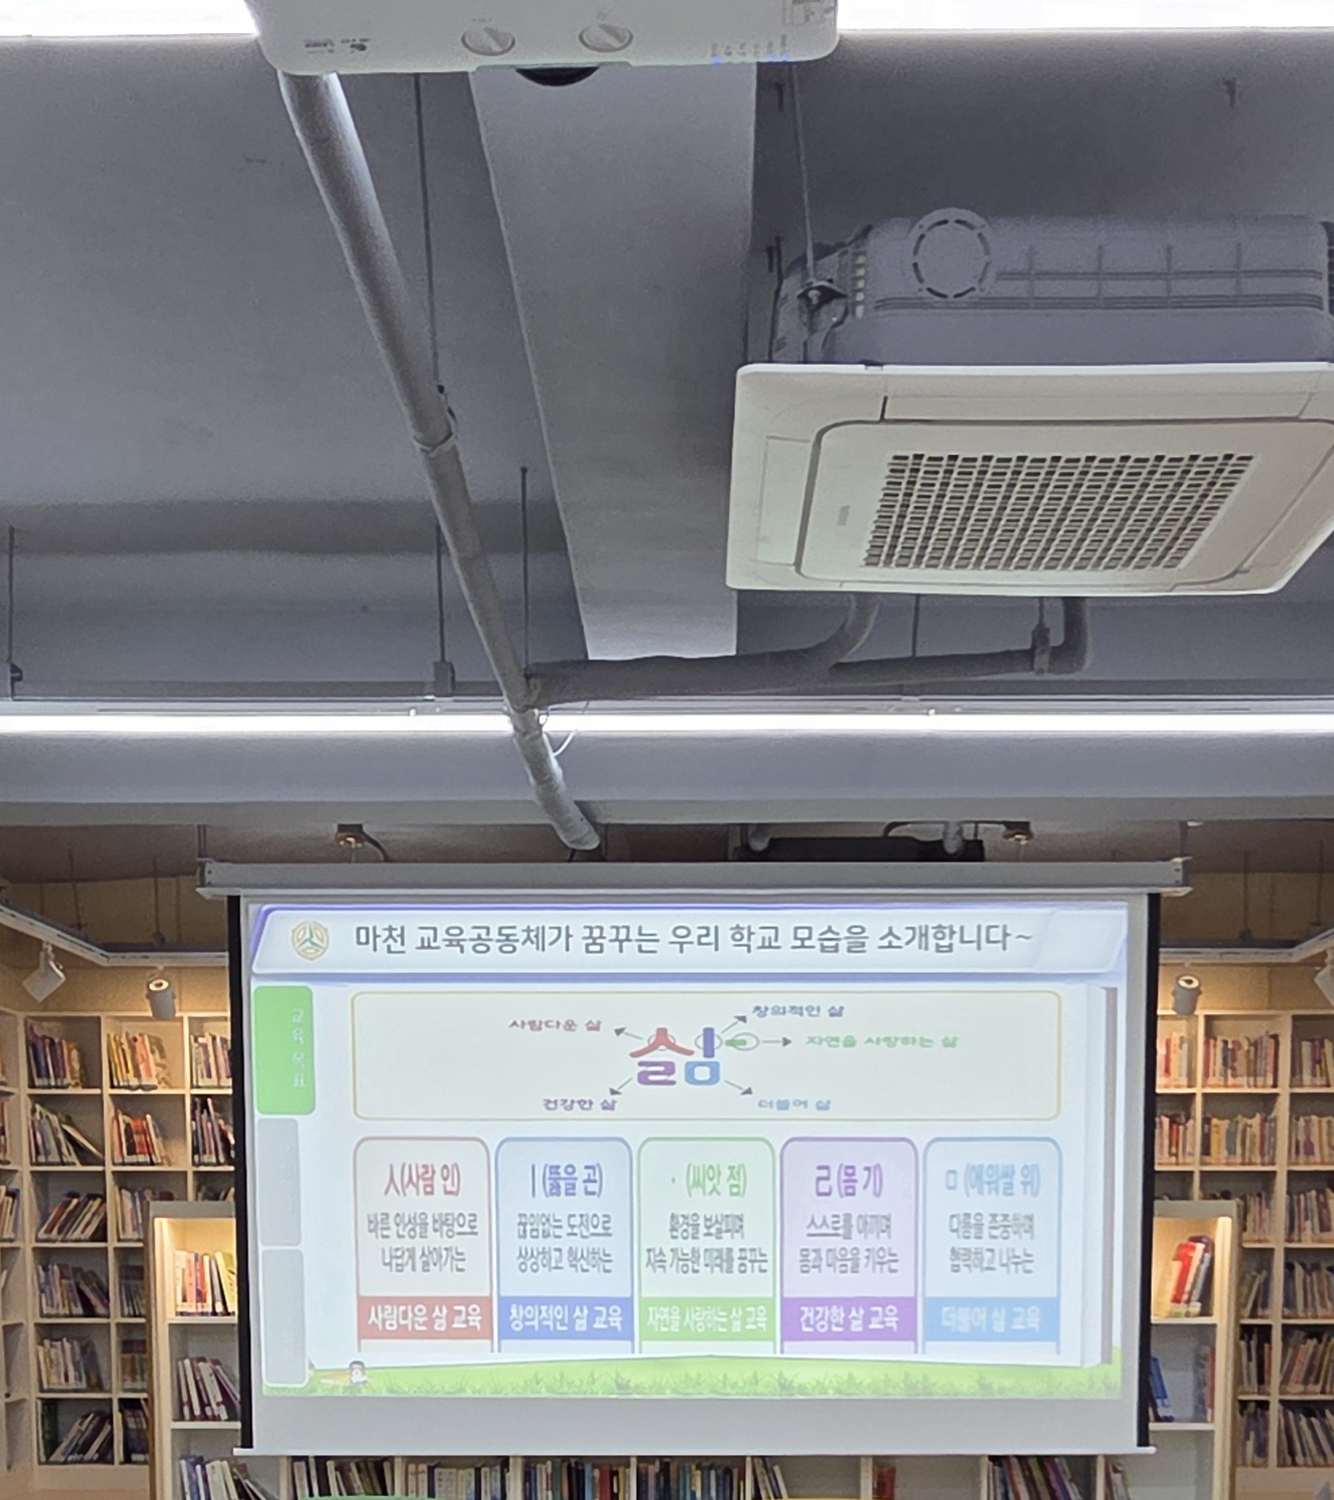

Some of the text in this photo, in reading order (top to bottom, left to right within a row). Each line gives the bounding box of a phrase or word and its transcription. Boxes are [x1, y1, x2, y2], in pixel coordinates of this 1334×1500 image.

[355, 924, 1034, 954] 마천 교육공동체가 꿈꾸는 우리 학교 모습을 소개합니다~
[509, 1018, 601, 1032] 사람다운 삶
[752, 1004, 845, 1018] 창의적인 삶
[805, 1035, 959, 1048] 자연을 사랑하는 삶
[543, 1098, 617, 1111] 건강한 삶
[758, 1098, 831, 1111] 더불어 삶
[686, 1162, 747, 1198] (씨앗 점)
[367, 1212, 479, 1239] 바른 인성을 바탕으로
[566, 1212, 613, 1240] 도전으로
[669, 1212, 700, 1240] 환경을
[949, 1212, 984, 1240] 다름을
[381, 1246, 466, 1273] 나답게 살아가는
[516, 1246, 613, 1274] 상상하고 혁신하는
[645, 1247, 667, 1274] 지속
[669, 1247, 701, 1274] 가능한
[737, 1247, 769, 1274] 꿈꾸는
[799, 1247, 900, 1274] 몸과 마음을 키우는
[999, 1246, 1035, 1274] 나누는
[367, 1304, 482, 1332] 사람다운 삶 교육
[509, 1304, 623, 1332] 창의적인 삶 교육
[647, 1304, 768, 1332] 자연을 사랑하는 삶 교육
[799, 1305, 899, 1332] 건강한 삶 교육
[1010, 1305, 1042, 1333] 교육
